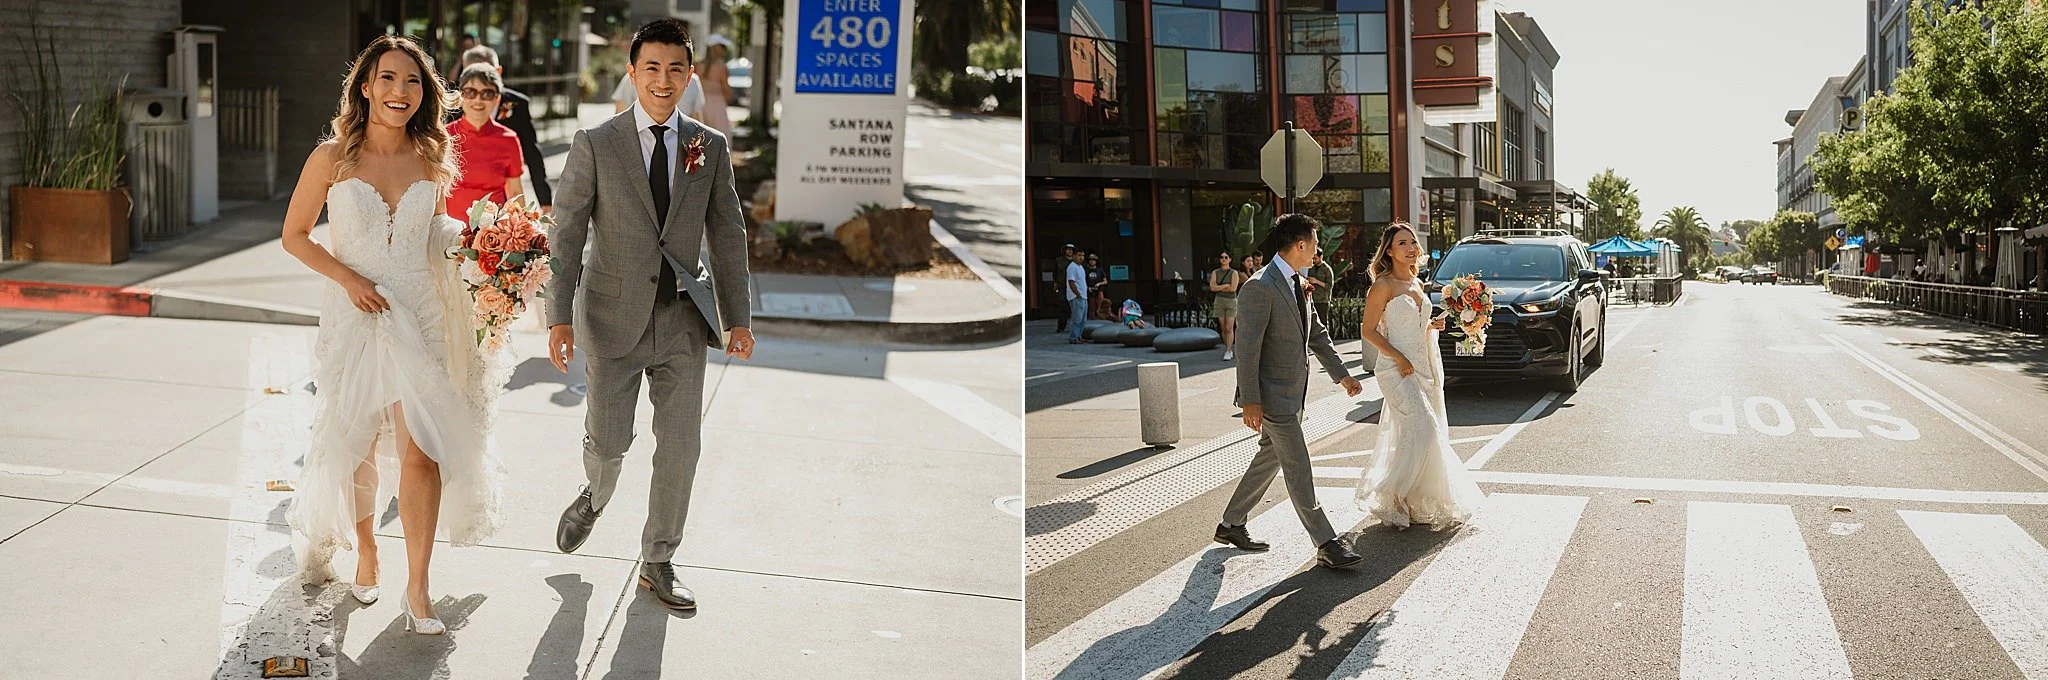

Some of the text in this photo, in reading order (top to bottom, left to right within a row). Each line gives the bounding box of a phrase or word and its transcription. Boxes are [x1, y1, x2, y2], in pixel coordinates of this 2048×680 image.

[824, 0, 881, 12] ENTER
[810, 16, 891, 48] 480
[816, 52, 882, 67] SPACES
[798, 72, 894, 88] AVAILABLE
[829, 118, 893, 130] SANTANA
[1847, 111, 1857, 126] P
[860, 134, 892, 144] ROW
[830, 147, 892, 158] PARKING
[831, 165, 892, 175] WEEKNIGHTS
[840, 176, 892, 186] WEEKENDS
[1688, 395, 1921, 441] STOP
